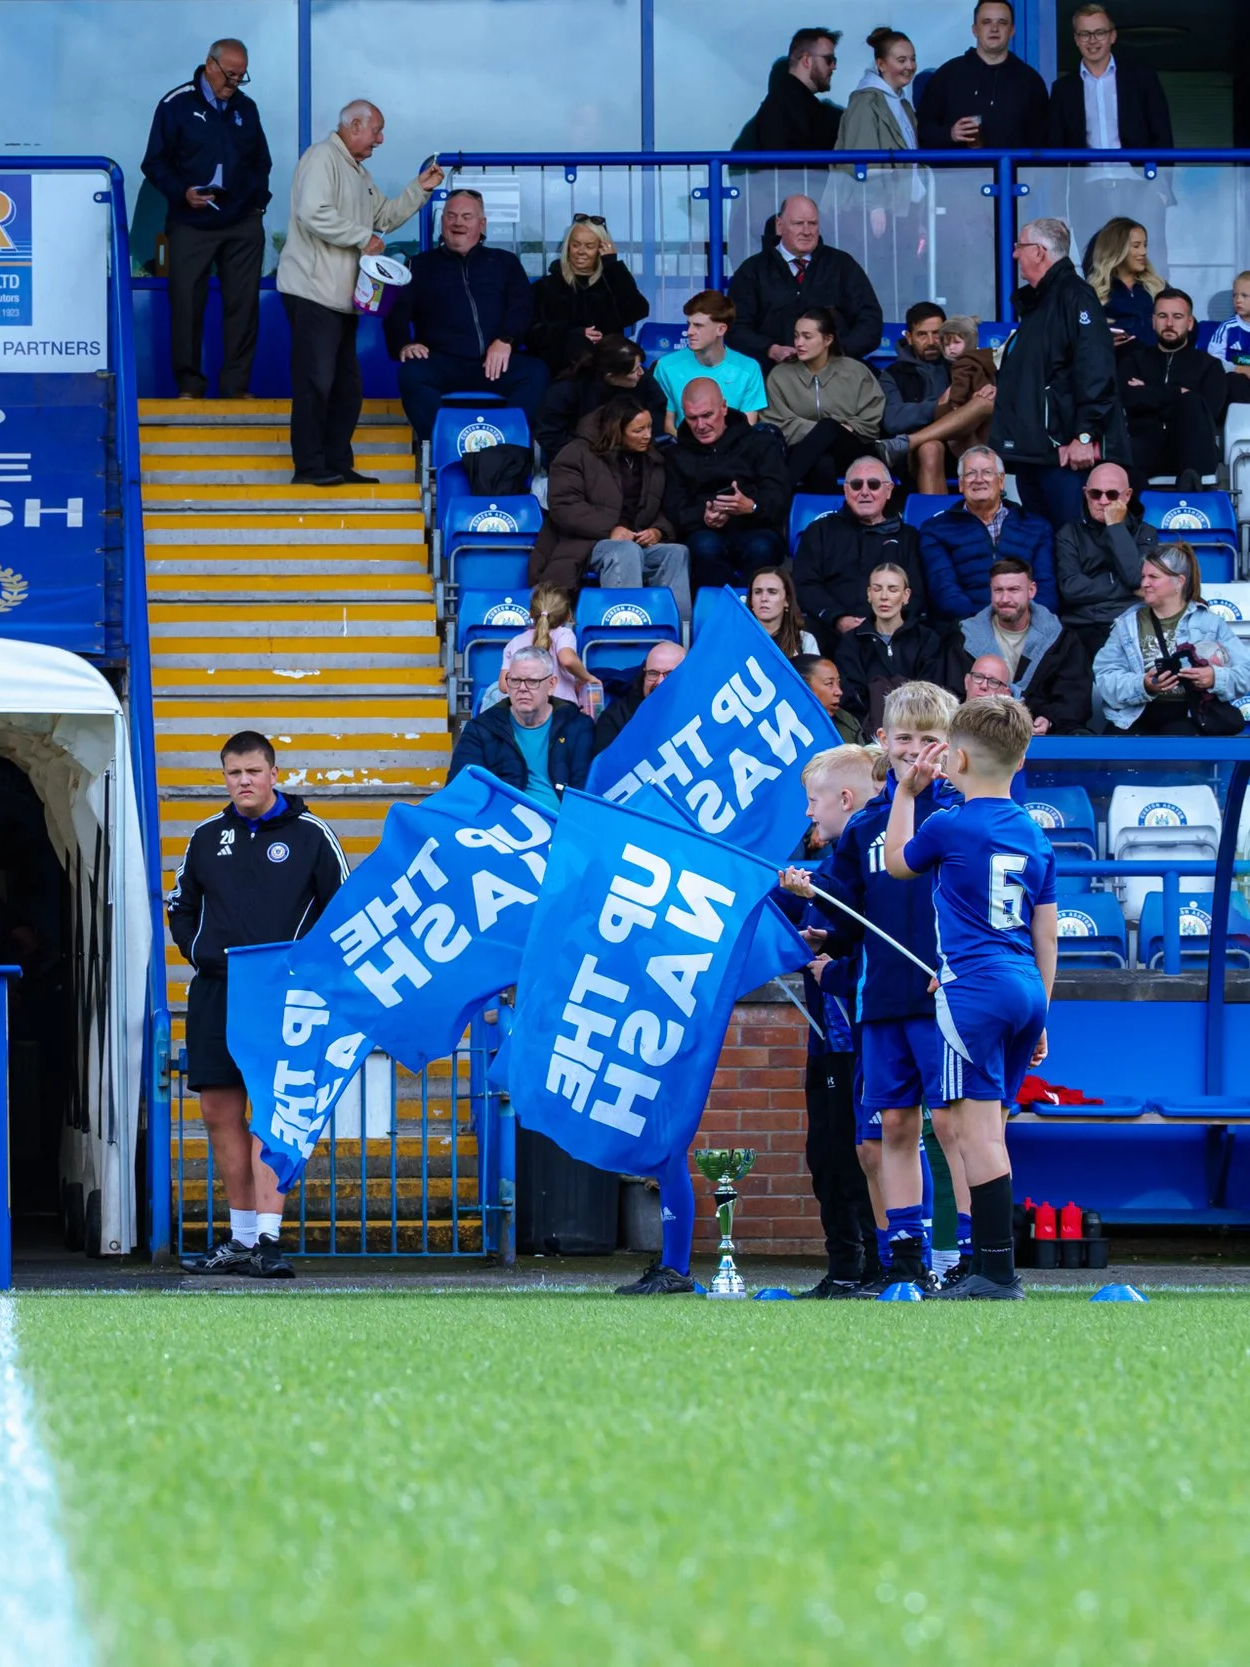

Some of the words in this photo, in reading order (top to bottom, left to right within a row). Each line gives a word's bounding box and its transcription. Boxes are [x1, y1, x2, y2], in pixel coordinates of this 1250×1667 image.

[4, 340, 101, 356] PARTNERS
[220, 829, 235, 845] 20
[989, 853, 1029, 930] 6
